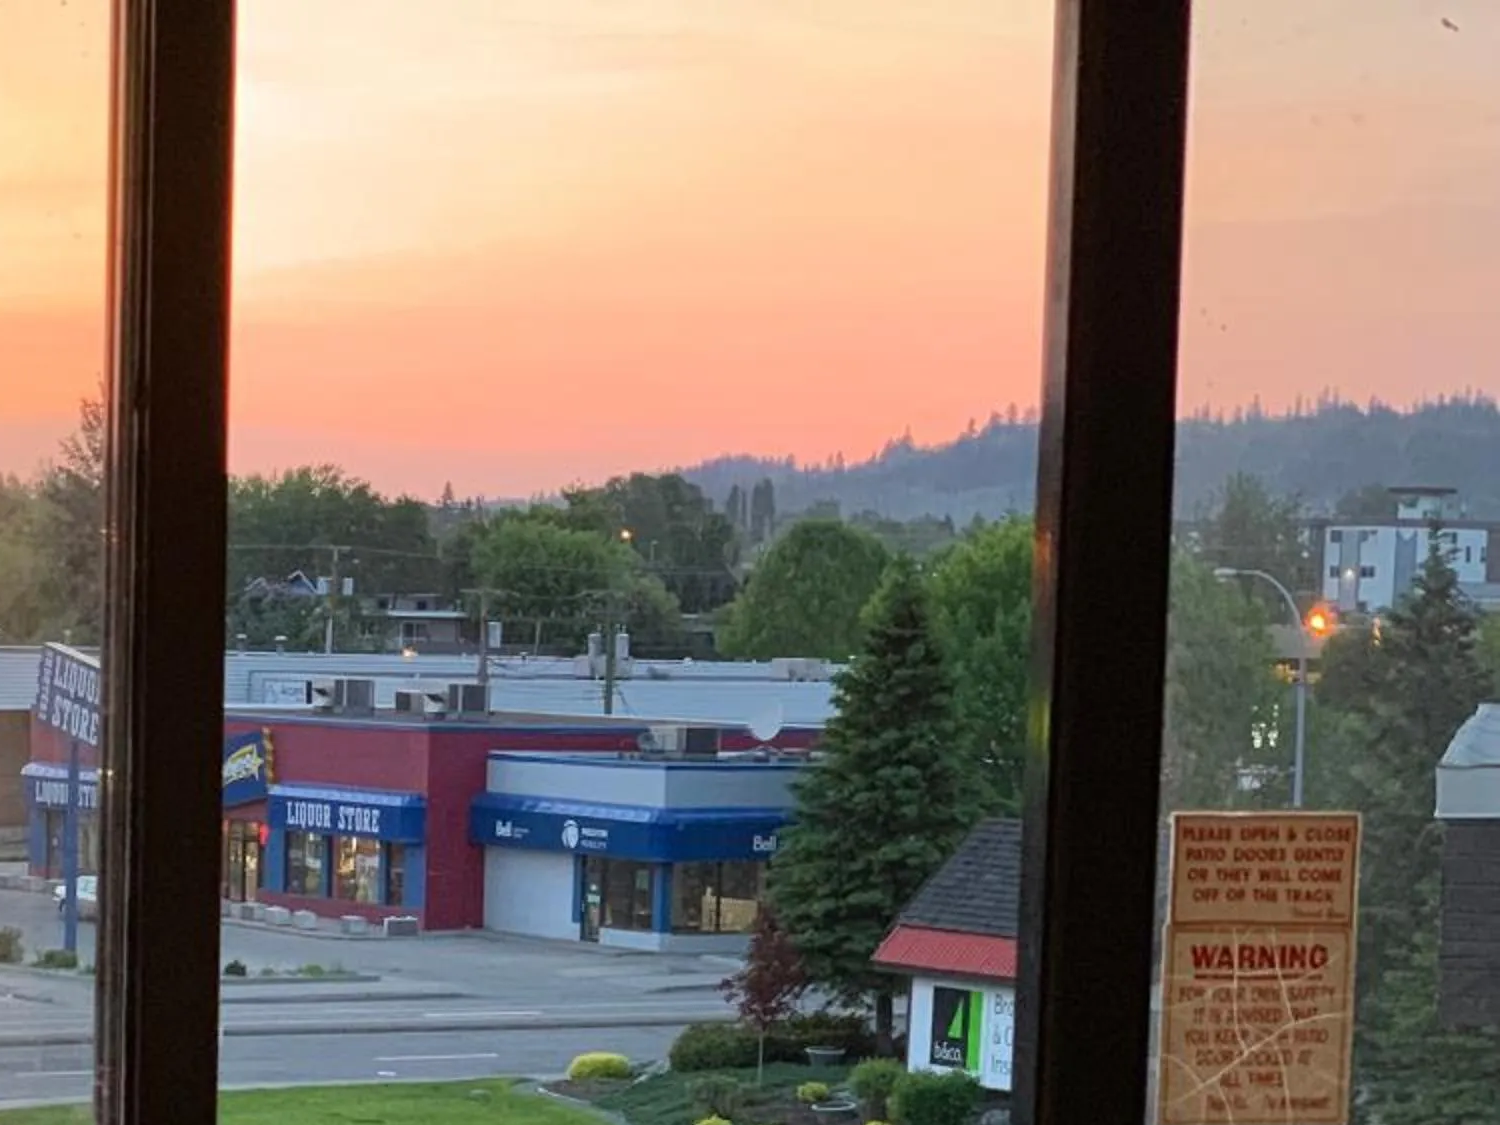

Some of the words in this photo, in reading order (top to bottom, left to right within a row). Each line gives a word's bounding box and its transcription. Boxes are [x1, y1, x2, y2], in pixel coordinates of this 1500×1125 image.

[51, 695, 99, 746] STORE
[35, 781, 69, 807] LIQUO
[286, 801, 331, 829] LIQUOR
[337, 804, 380, 833] STORE
[1183, 826, 1232, 842] PLEASE
[1240, 826, 1280, 842] OPEN
[1304, 826, 1351, 842] CLOSE
[753, 836, 777, 852] Bell
[1185, 847, 1227, 862] PATIO
[1233, 847, 1287, 862] DOORS
[1187, 868, 1209, 883] OR
[1216, 868, 1251, 883] THEY
[1259, 868, 1292, 883] WILL
[1298, 868, 1343, 883] COME
[1192, 888, 1220, 903] OFF
[1226, 888, 1246, 903] OF
[1252, 888, 1278, 903] THE
[1285, 888, 1335, 903] TRACK
[1190, 944, 1329, 969] WARNING
